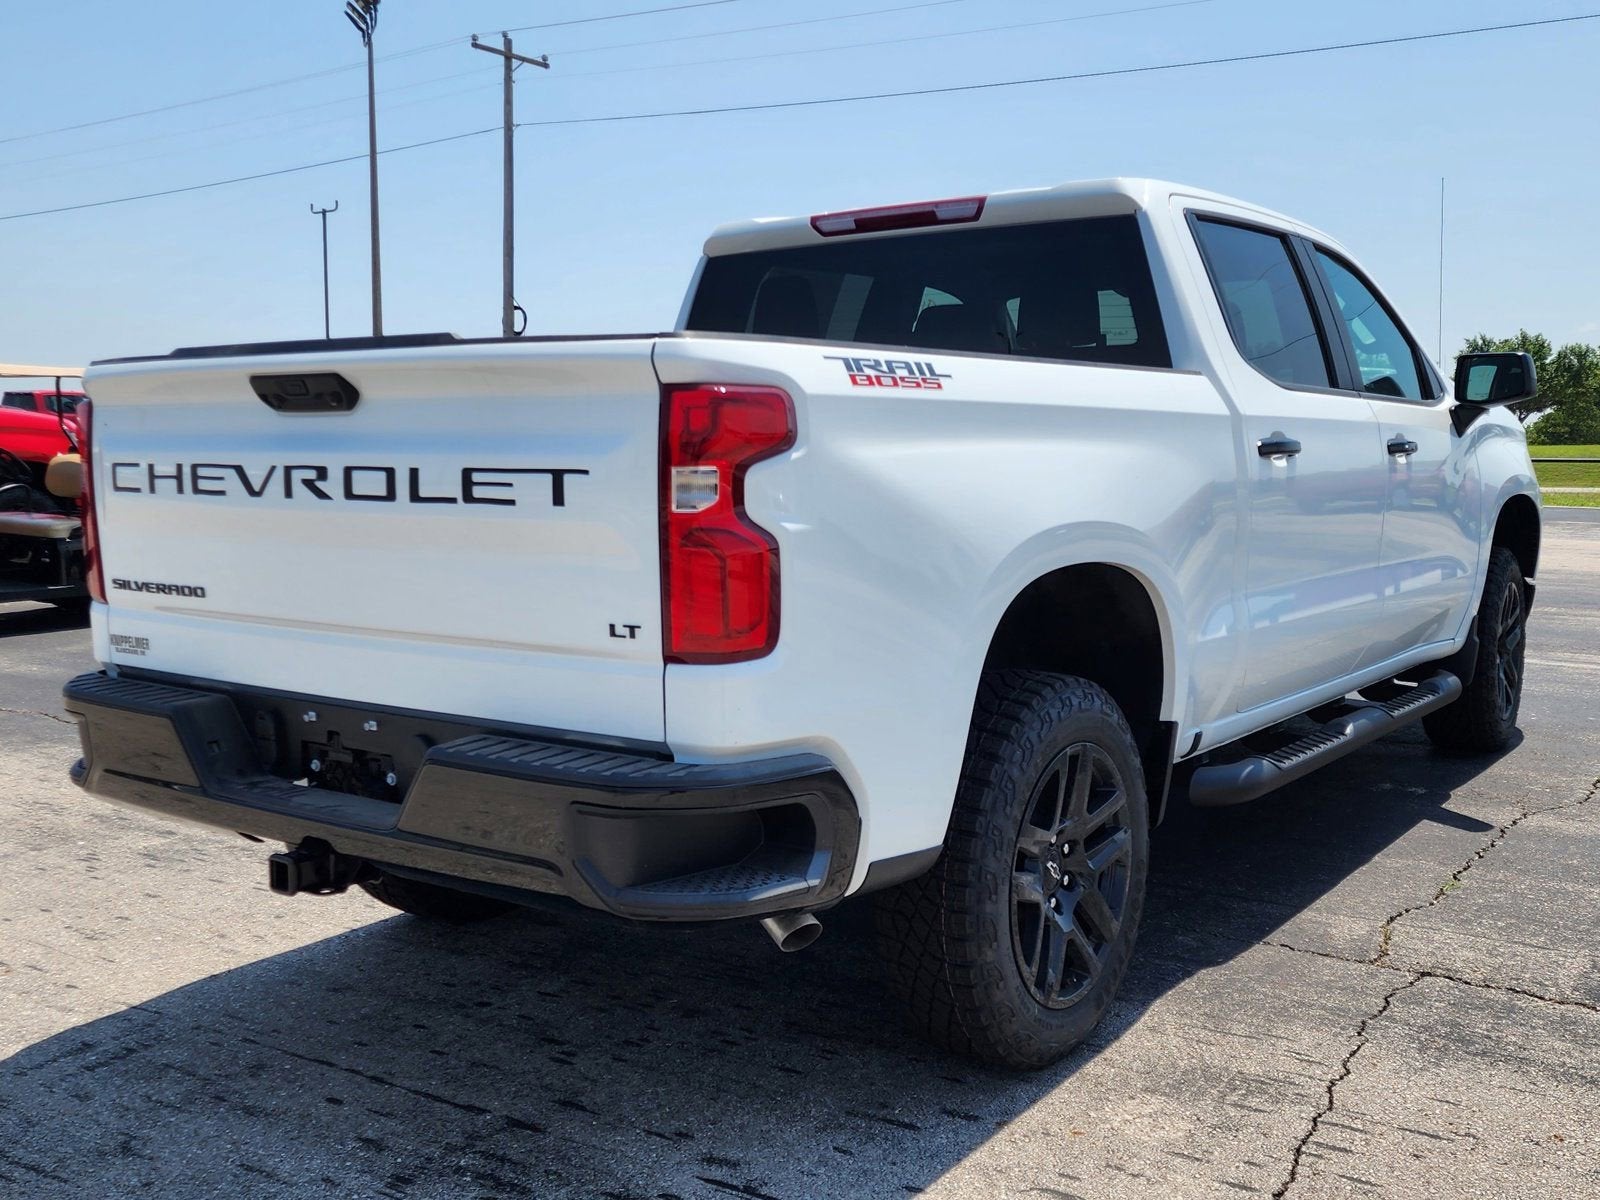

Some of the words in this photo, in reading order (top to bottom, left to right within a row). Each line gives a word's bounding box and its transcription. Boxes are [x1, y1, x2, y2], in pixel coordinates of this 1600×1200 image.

[823, 356, 952, 378] TRAIL
[849, 374, 942, 389] BOSS
[111, 462, 589, 507] CHEVROLET
[111, 578, 206, 598] SILVERADO
[609, 623, 641, 640] LT
